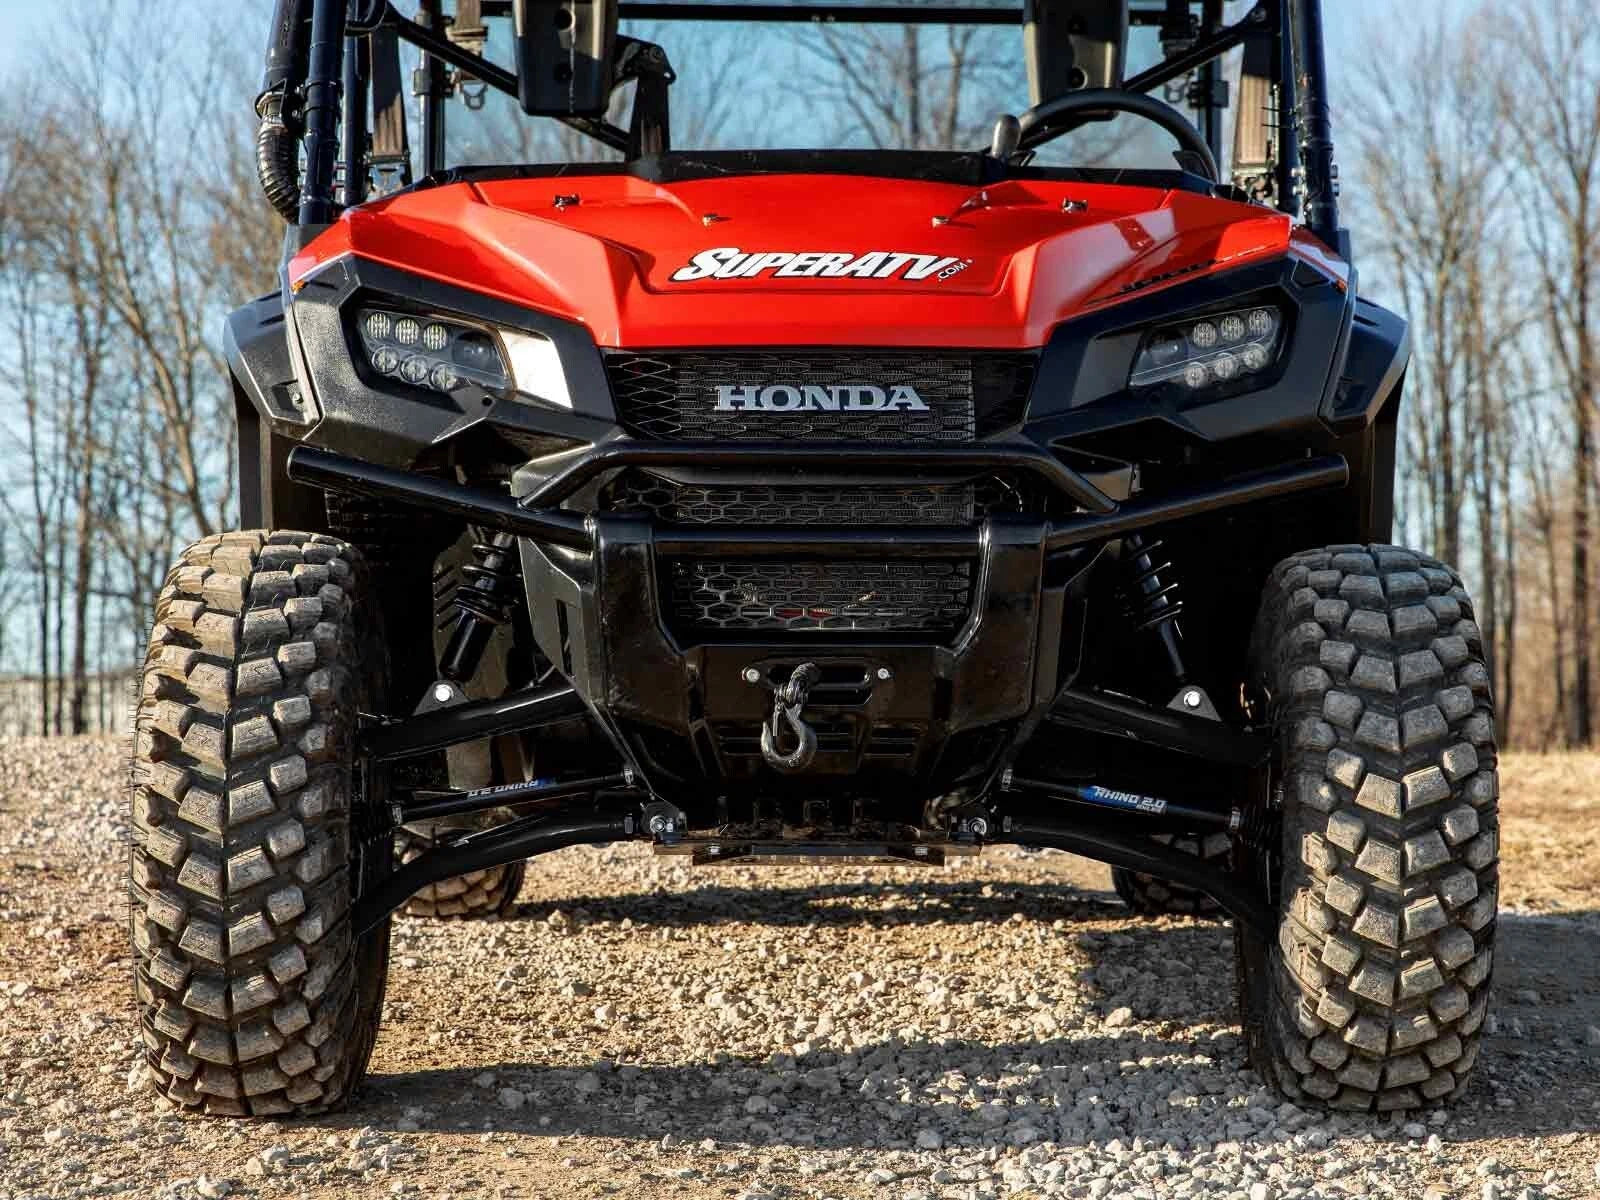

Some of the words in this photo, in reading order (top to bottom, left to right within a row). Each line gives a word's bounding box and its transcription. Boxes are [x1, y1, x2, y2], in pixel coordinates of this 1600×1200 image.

[714, 385, 930, 411] HONDA
[1090, 785, 1140, 804] RHINO
[1141, 796, 1168, 809] 2.0
